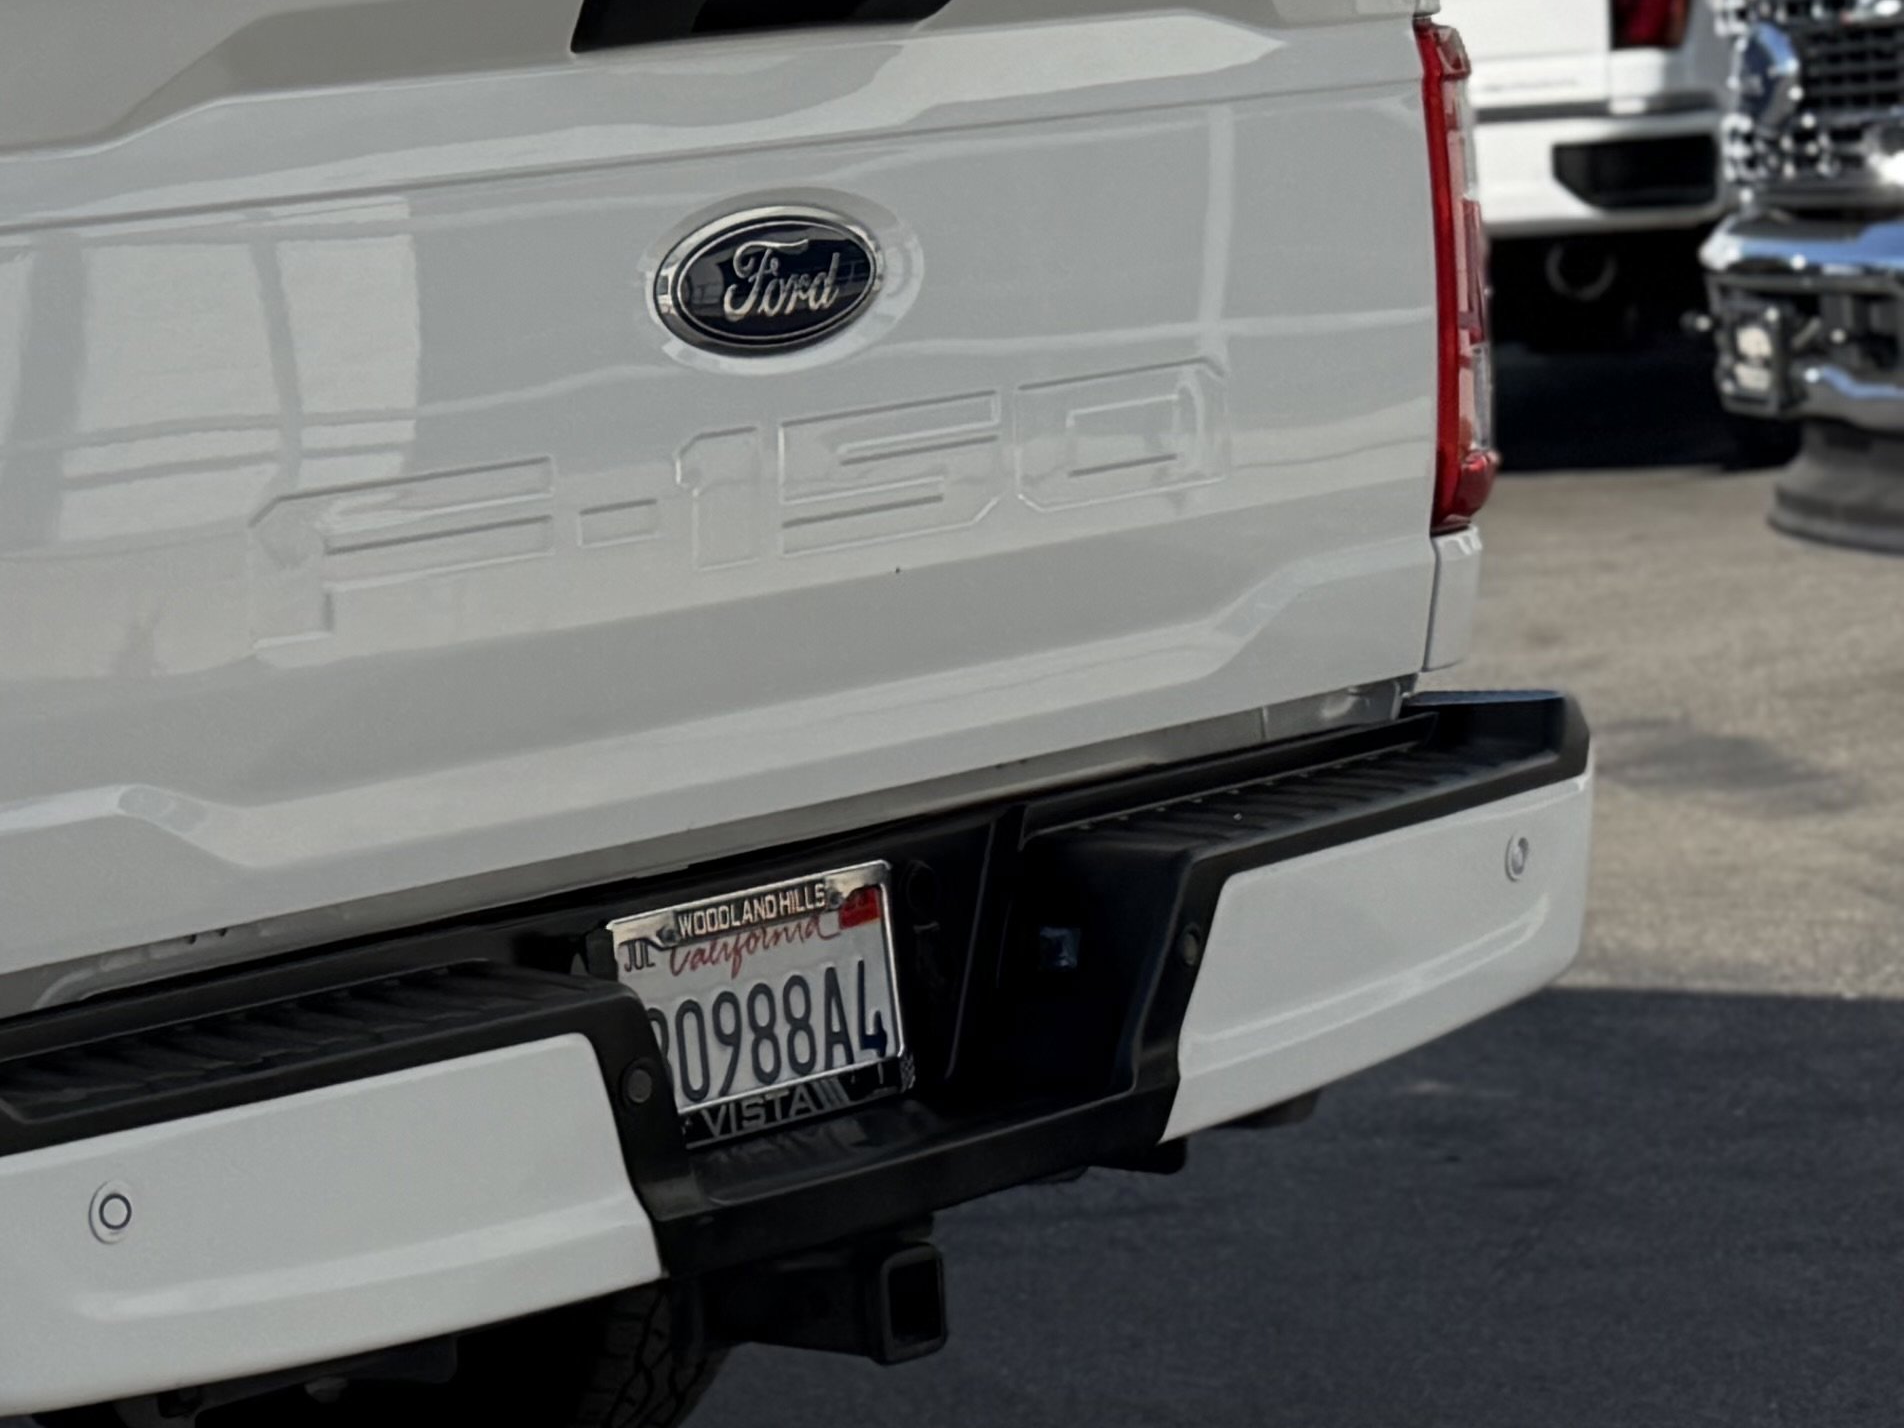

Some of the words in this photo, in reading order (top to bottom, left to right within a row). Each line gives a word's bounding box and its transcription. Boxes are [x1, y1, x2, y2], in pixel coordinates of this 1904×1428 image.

[723, 238, 840, 323] Ford
[248, 358, 1229, 652] F-150
[677, 894, 778, 939] WOODLAND
[778, 882, 826, 916] HILLS
[700, 1083, 819, 1138] VISTA
